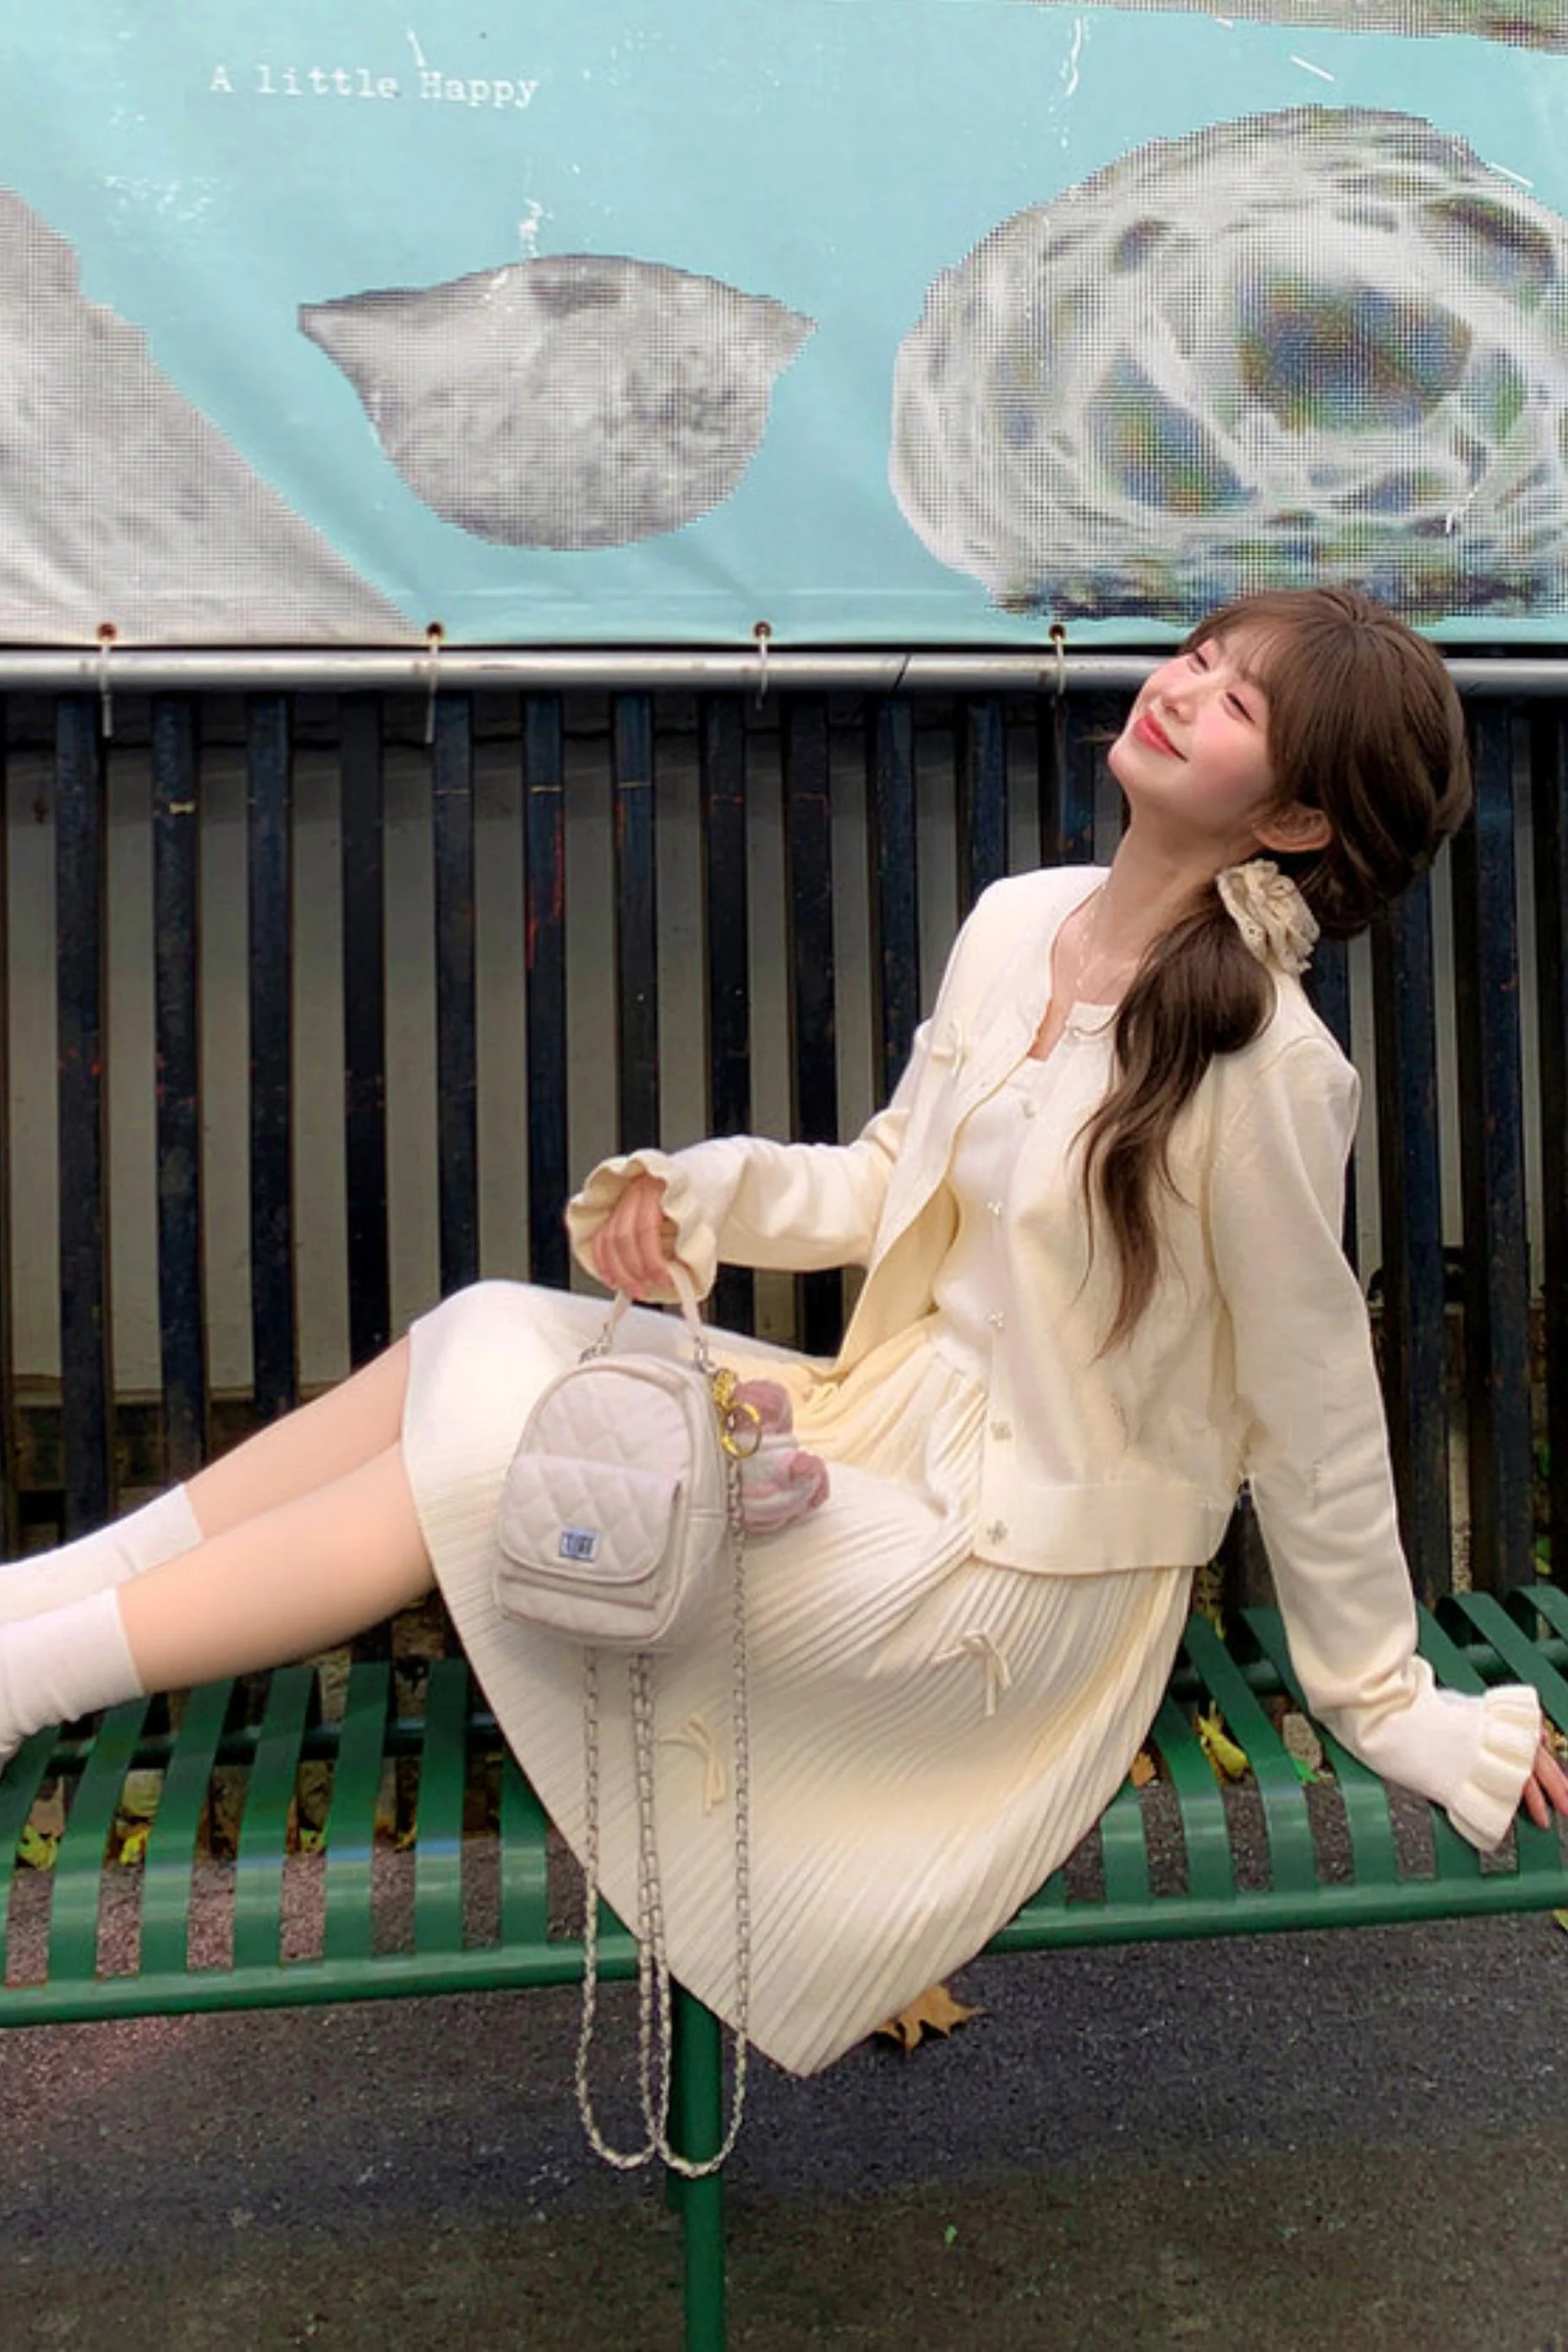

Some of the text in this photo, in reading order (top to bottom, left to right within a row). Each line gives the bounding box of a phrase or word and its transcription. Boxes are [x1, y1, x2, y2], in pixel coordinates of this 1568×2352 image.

[210, 65, 539, 107] A little Happy
